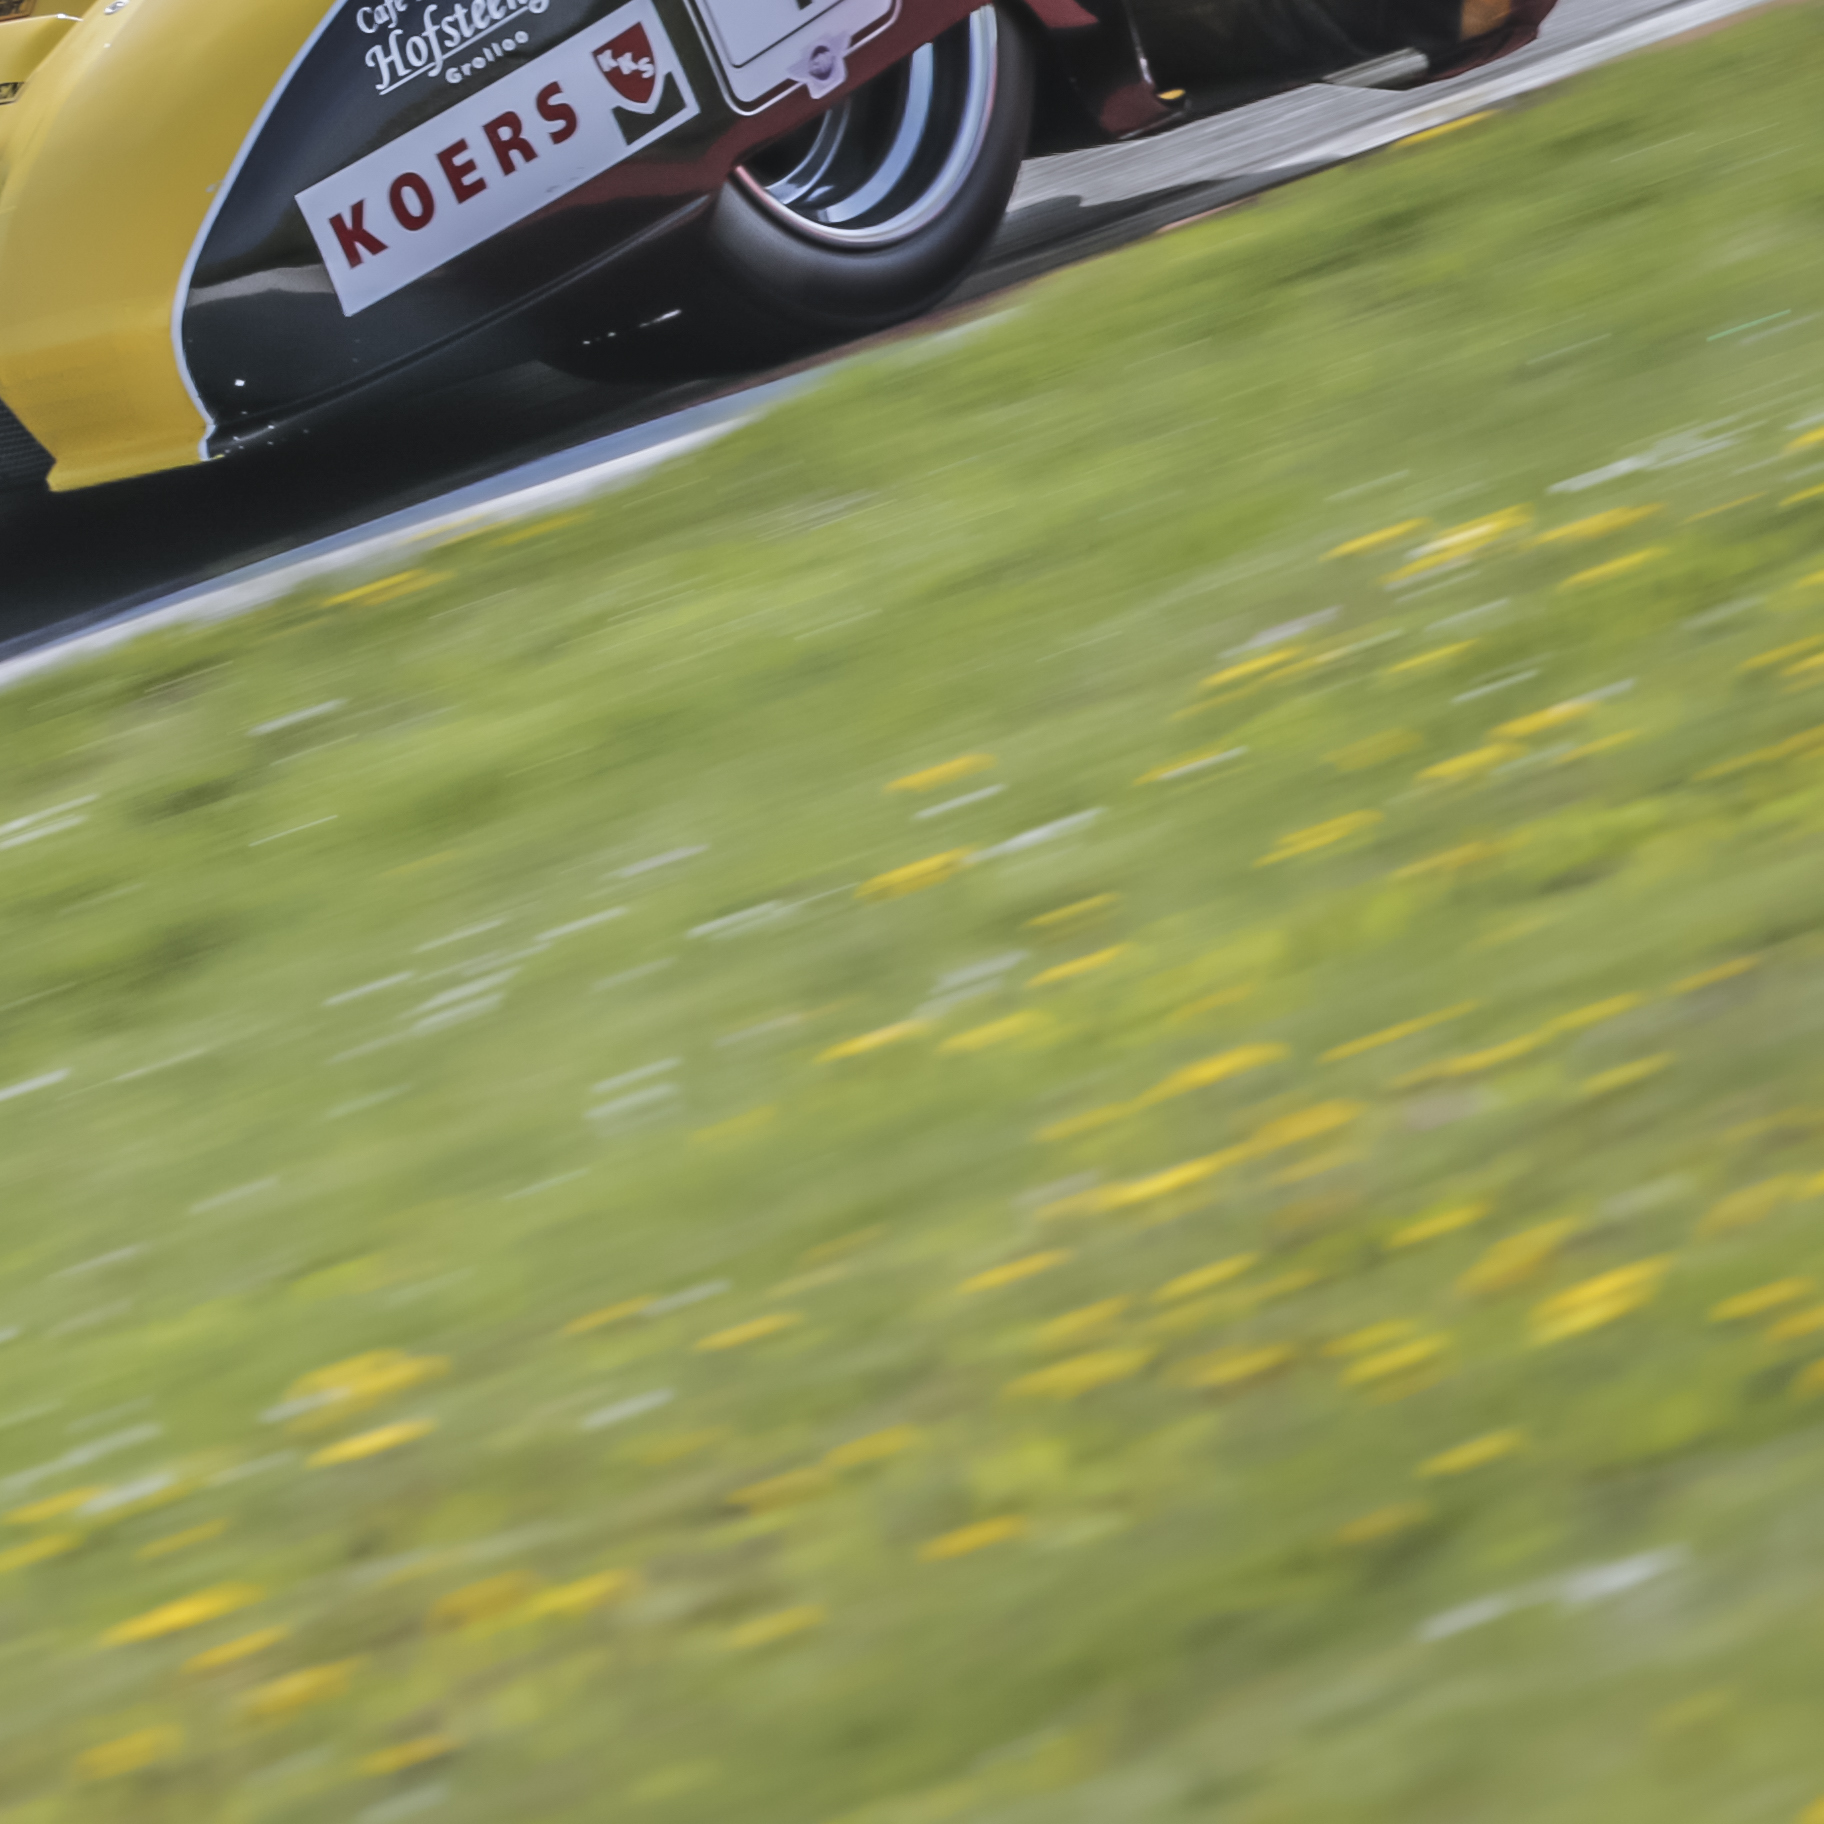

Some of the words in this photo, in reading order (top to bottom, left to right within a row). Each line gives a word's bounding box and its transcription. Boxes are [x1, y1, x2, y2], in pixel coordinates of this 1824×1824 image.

[445, 31, 529, 84] Grolloo
[596, 48, 656, 79] KKS
[327, 81, 579, 269] KOERS
